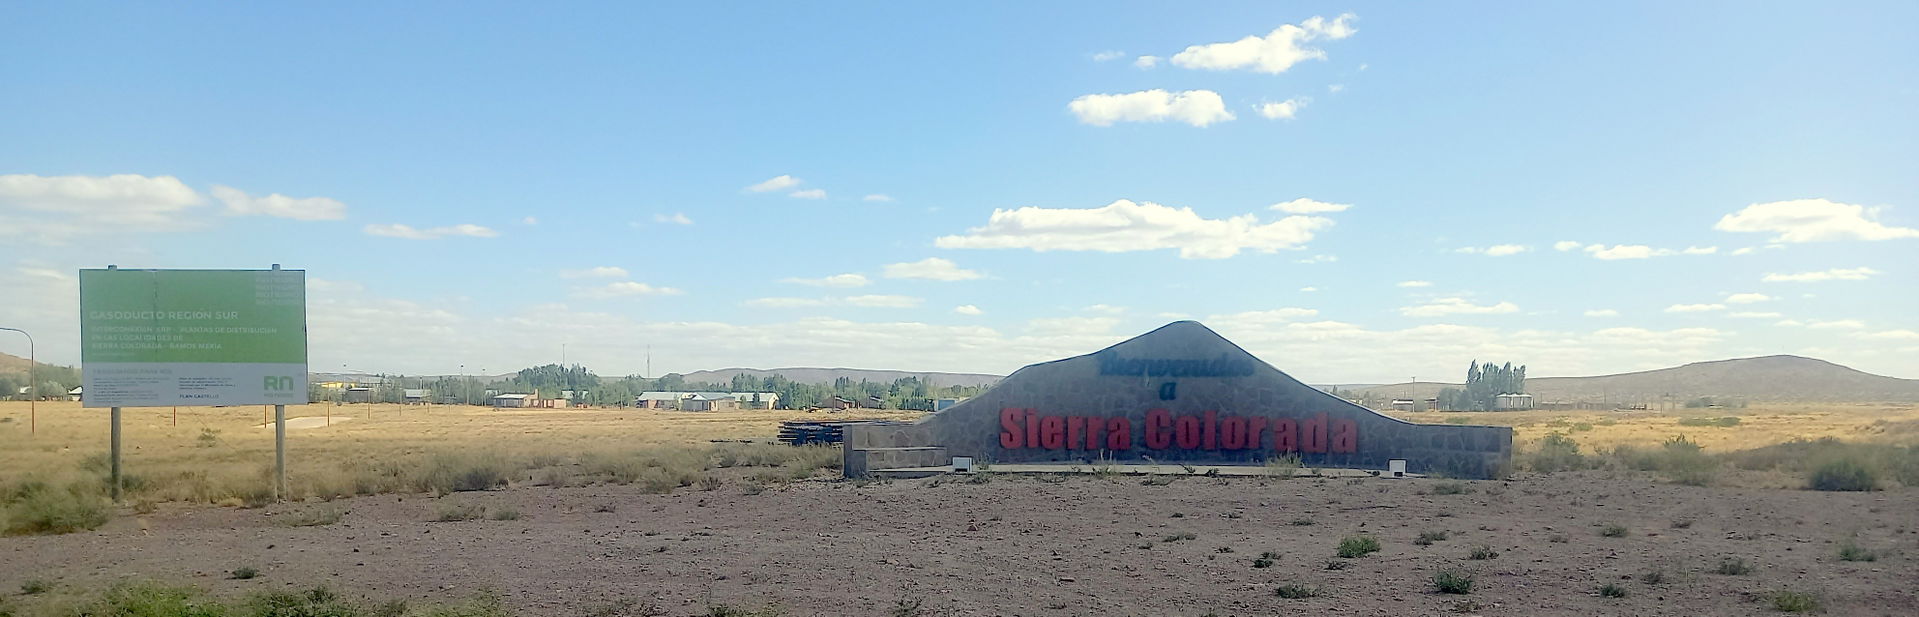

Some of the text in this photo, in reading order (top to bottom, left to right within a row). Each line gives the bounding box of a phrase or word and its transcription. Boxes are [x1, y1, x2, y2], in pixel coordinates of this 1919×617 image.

[90, 311, 165, 320] GASODUCTO
[215, 311, 239, 320] SUR
[1159, 382, 1176, 400] a
[999, 407, 1358, 454] Sierra Colorada
